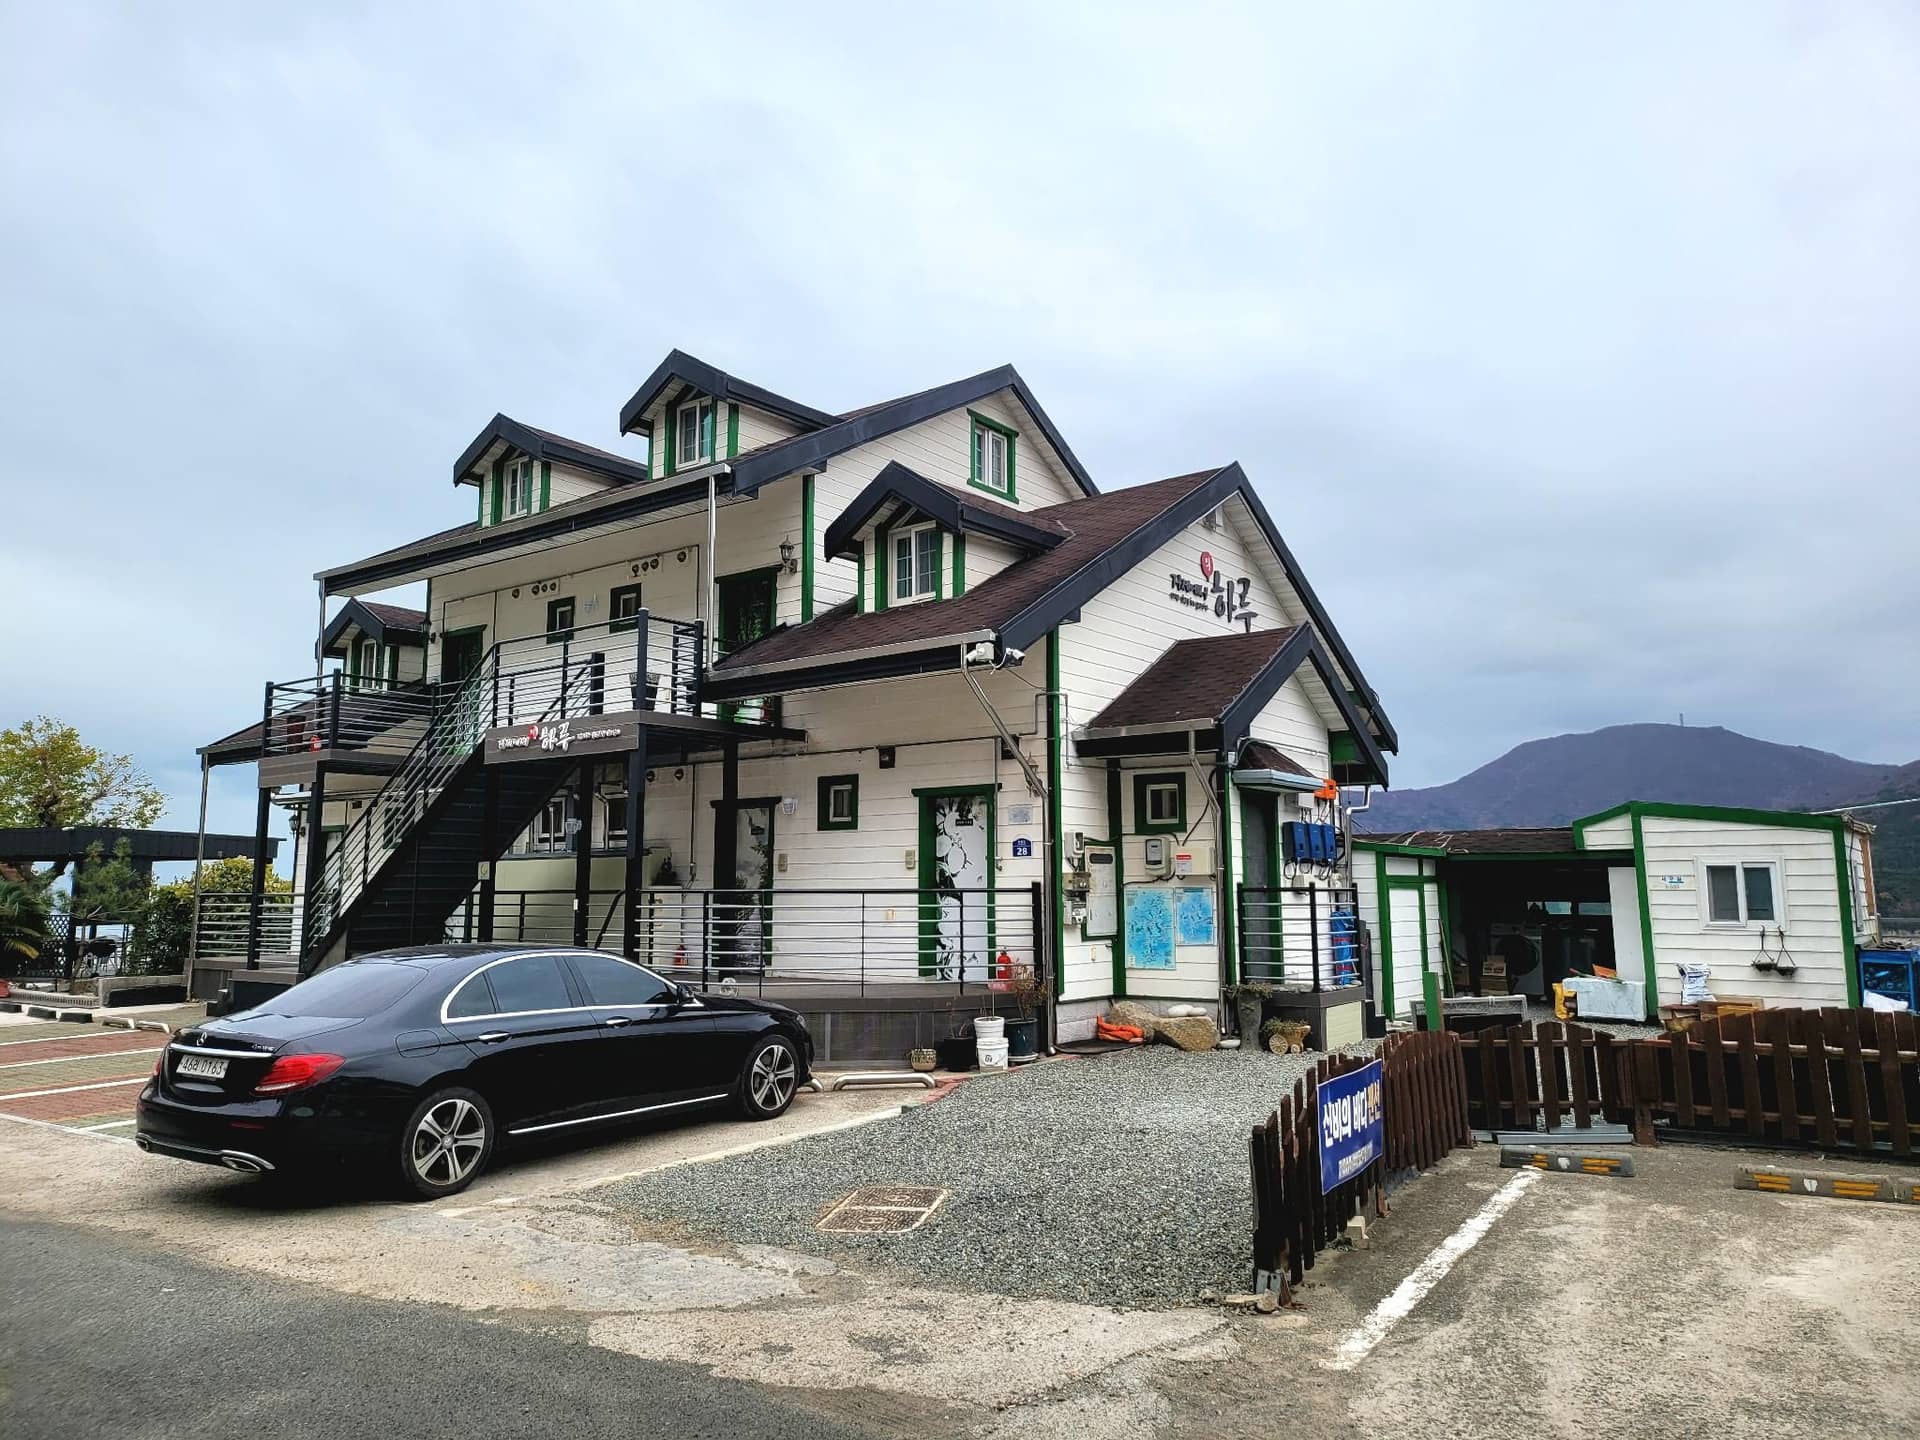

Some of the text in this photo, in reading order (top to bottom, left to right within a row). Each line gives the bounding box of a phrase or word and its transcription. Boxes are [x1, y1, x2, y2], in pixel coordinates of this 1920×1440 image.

[1211, 570, 1258, 633] 하루
[540, 721, 576, 752] 하루
[1016, 847, 1028, 855] 28
